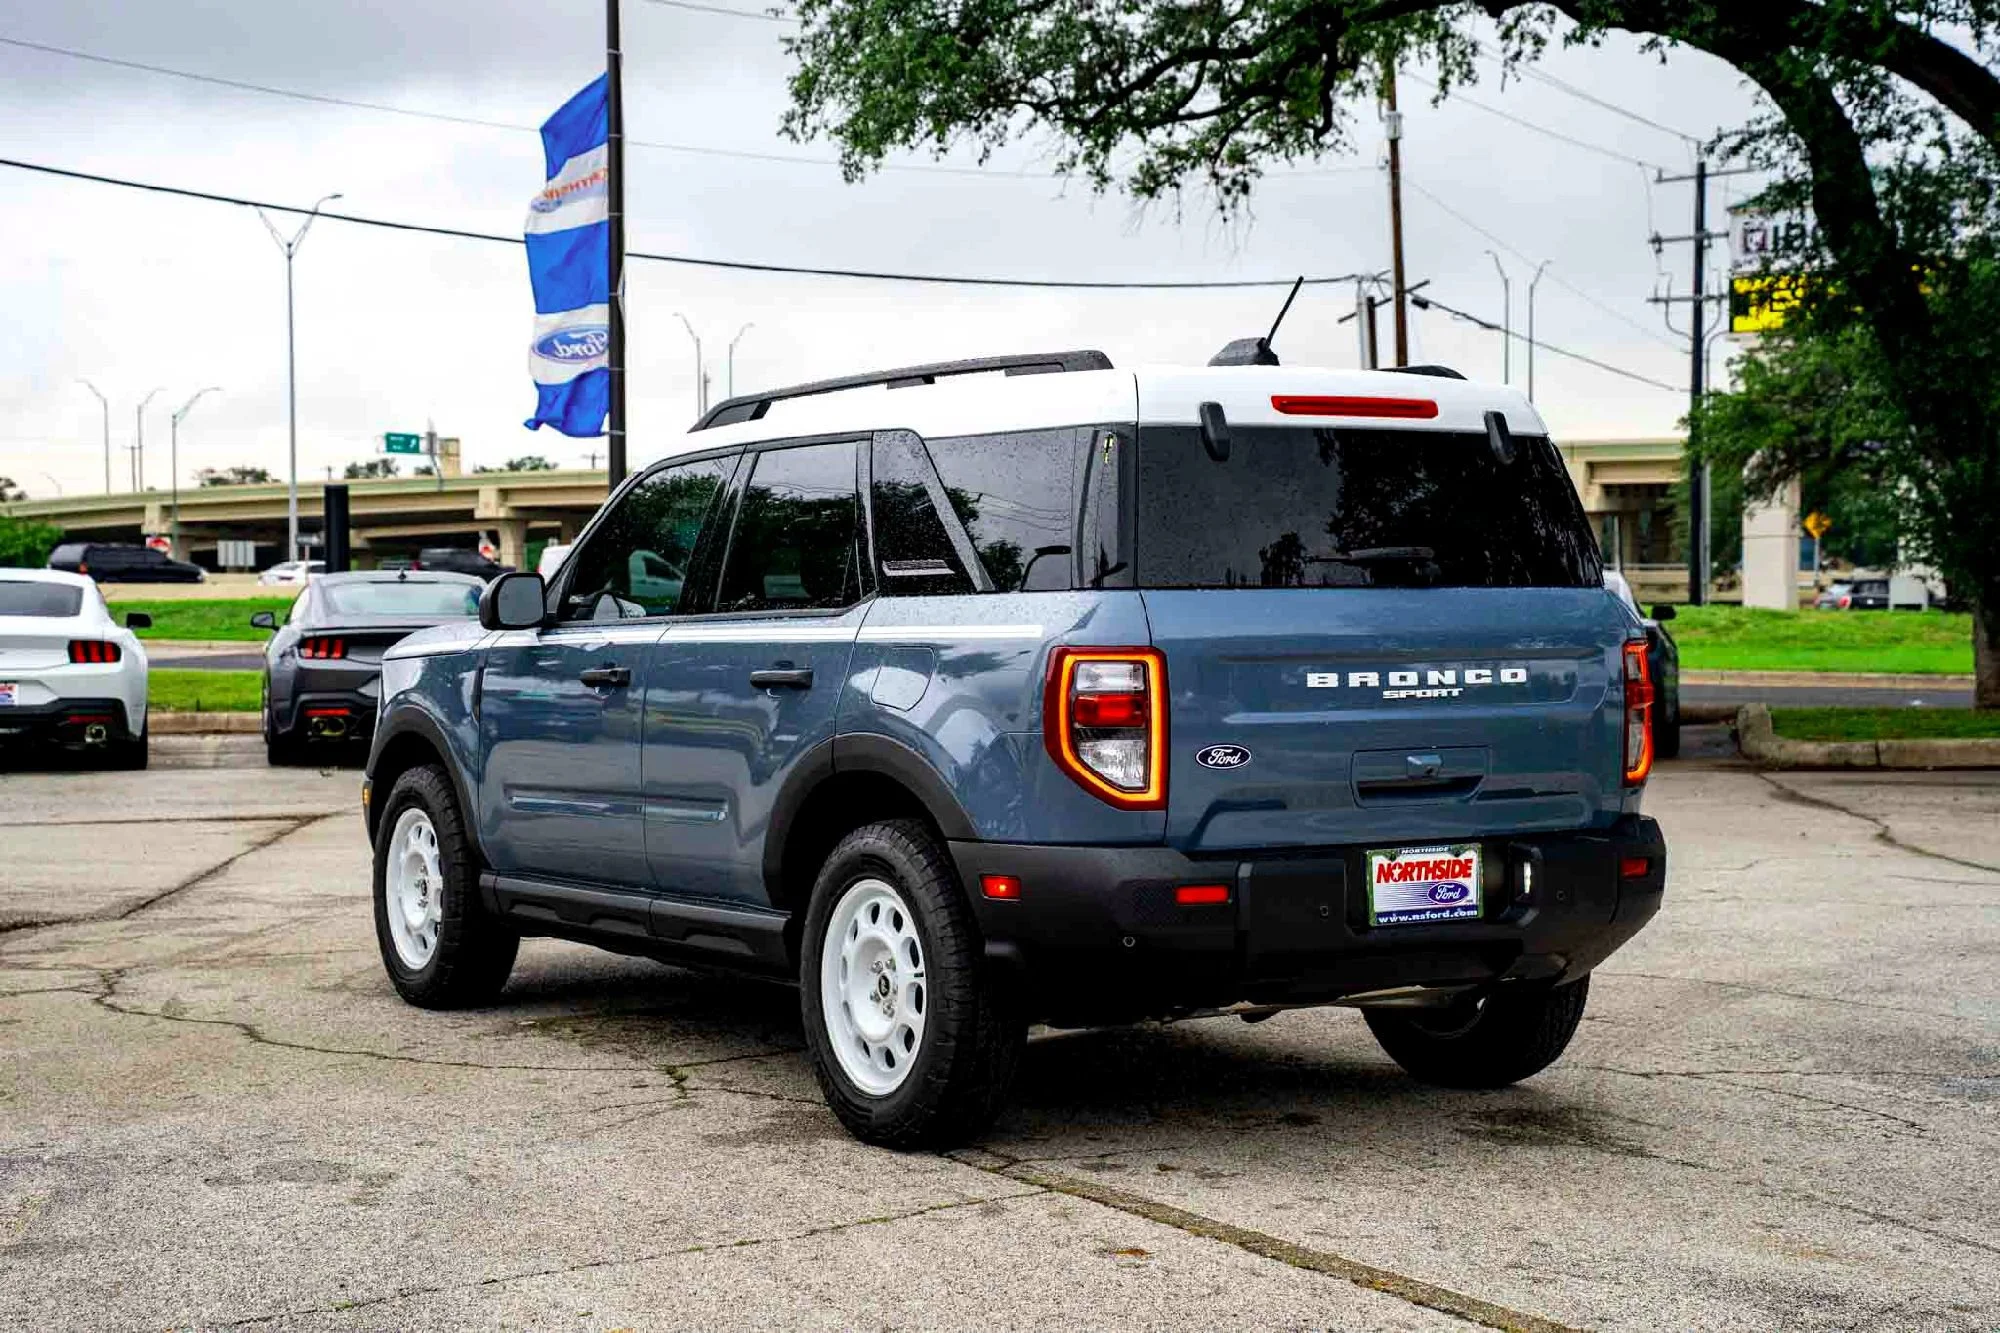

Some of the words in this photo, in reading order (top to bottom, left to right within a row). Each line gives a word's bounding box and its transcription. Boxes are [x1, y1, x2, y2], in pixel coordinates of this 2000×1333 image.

[1306, 668, 1527, 687] BRONCO
[1382, 688, 1464, 699] SPORT
[1207, 748, 1242, 765] Ford
[1401, 846, 1449, 855] NORTHSIDE
[1376, 858, 1473, 883] NORTHSIDE
[1435, 884, 1461, 900] Ford
[1378, 908, 1478, 923] www.nsford.com
